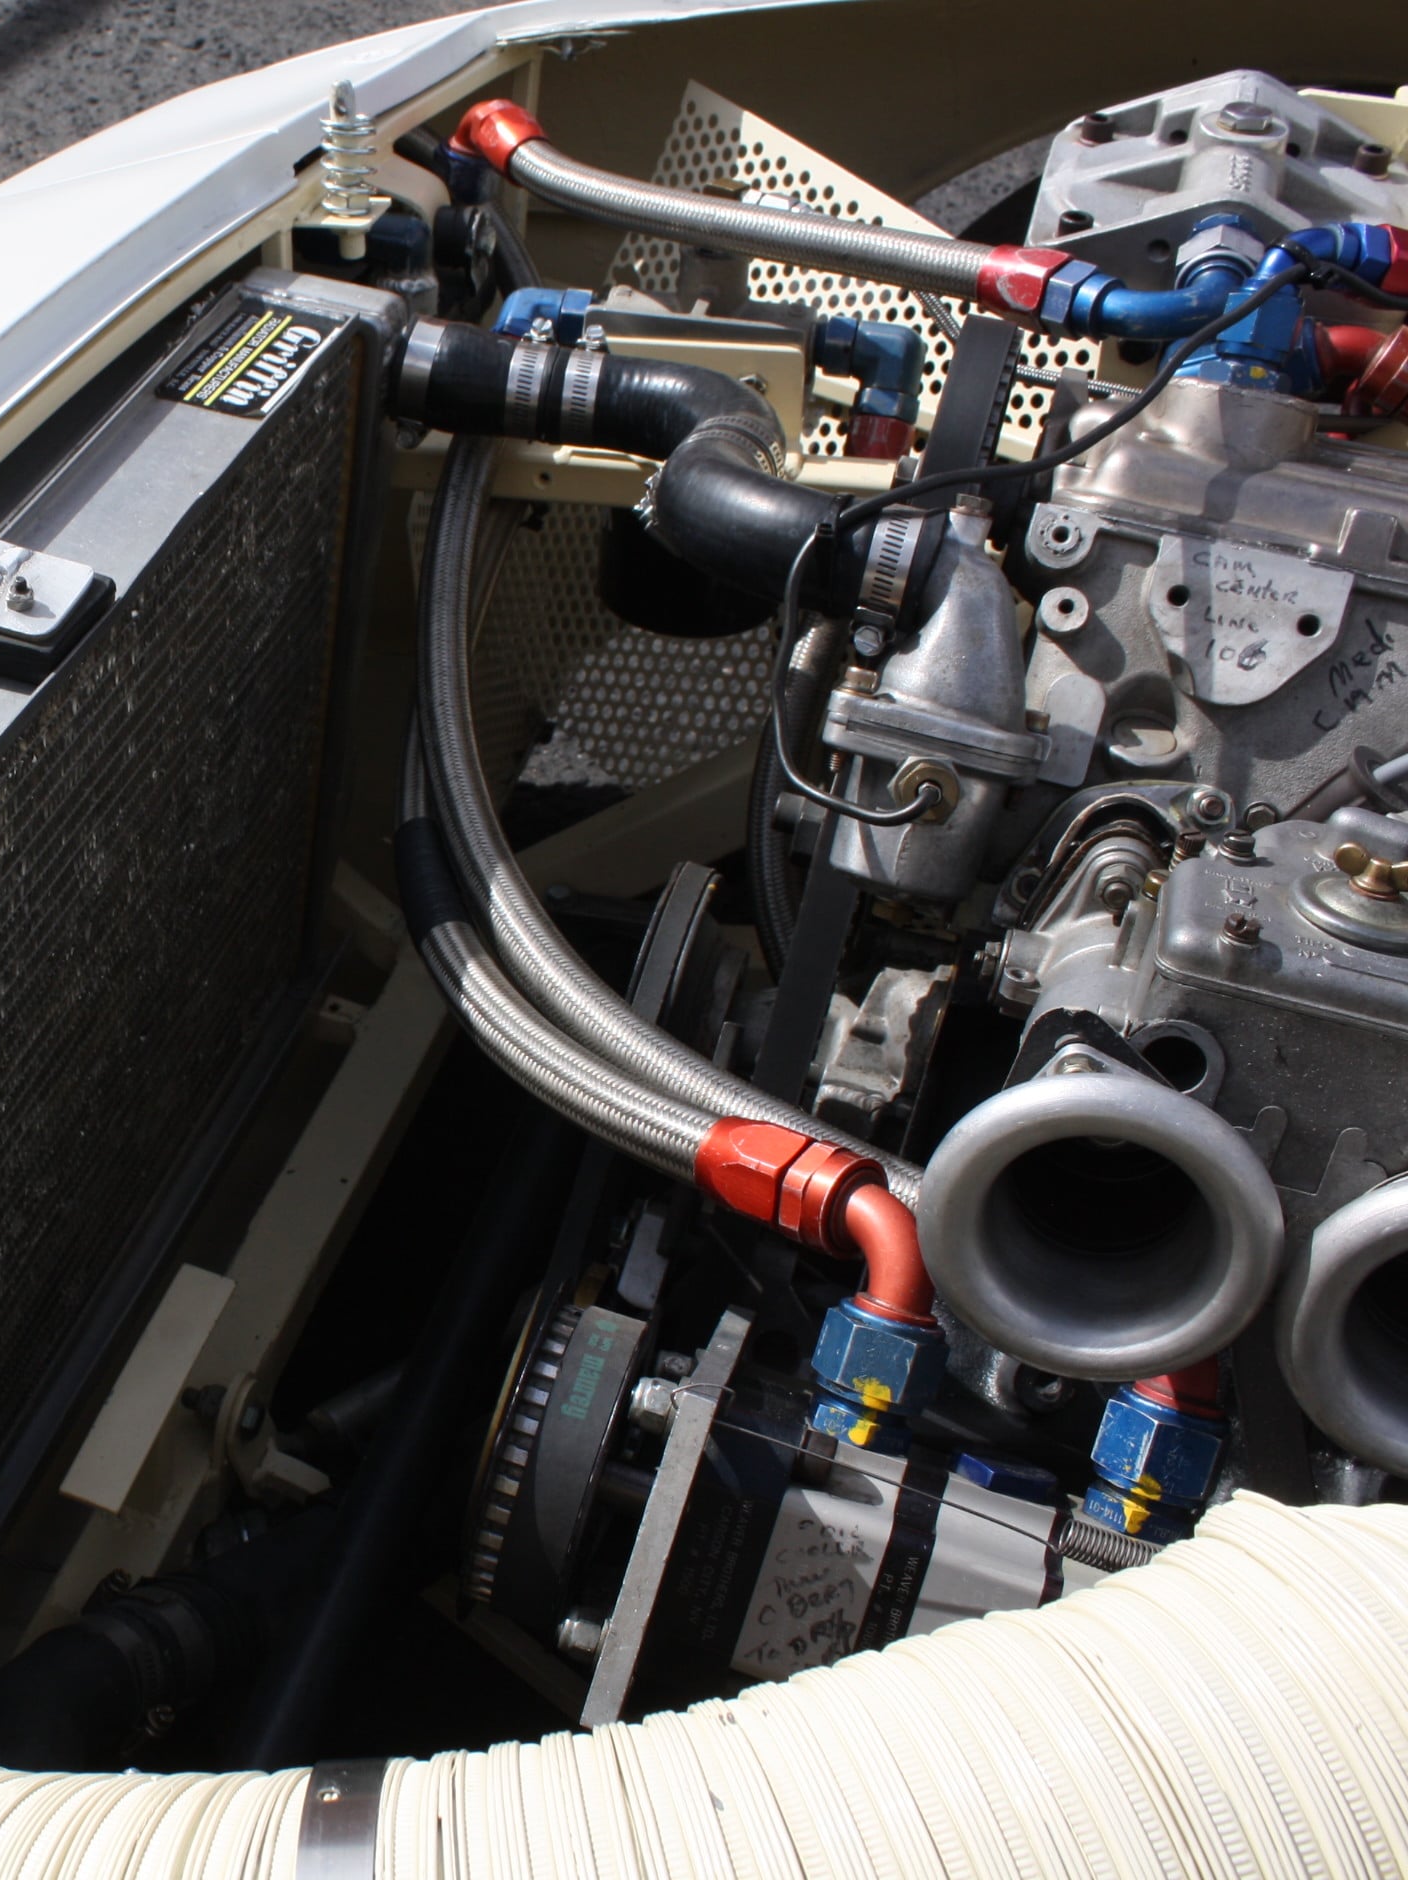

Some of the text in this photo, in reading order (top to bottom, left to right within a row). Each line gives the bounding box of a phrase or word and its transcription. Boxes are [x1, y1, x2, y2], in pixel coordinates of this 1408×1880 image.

[247, 317, 282, 348] RADIATOR
[196, 346, 253, 400] MANUFACTURERS
[220, 326, 322, 406] Griffin
[896, 1557, 921, 1604] WEAVER
